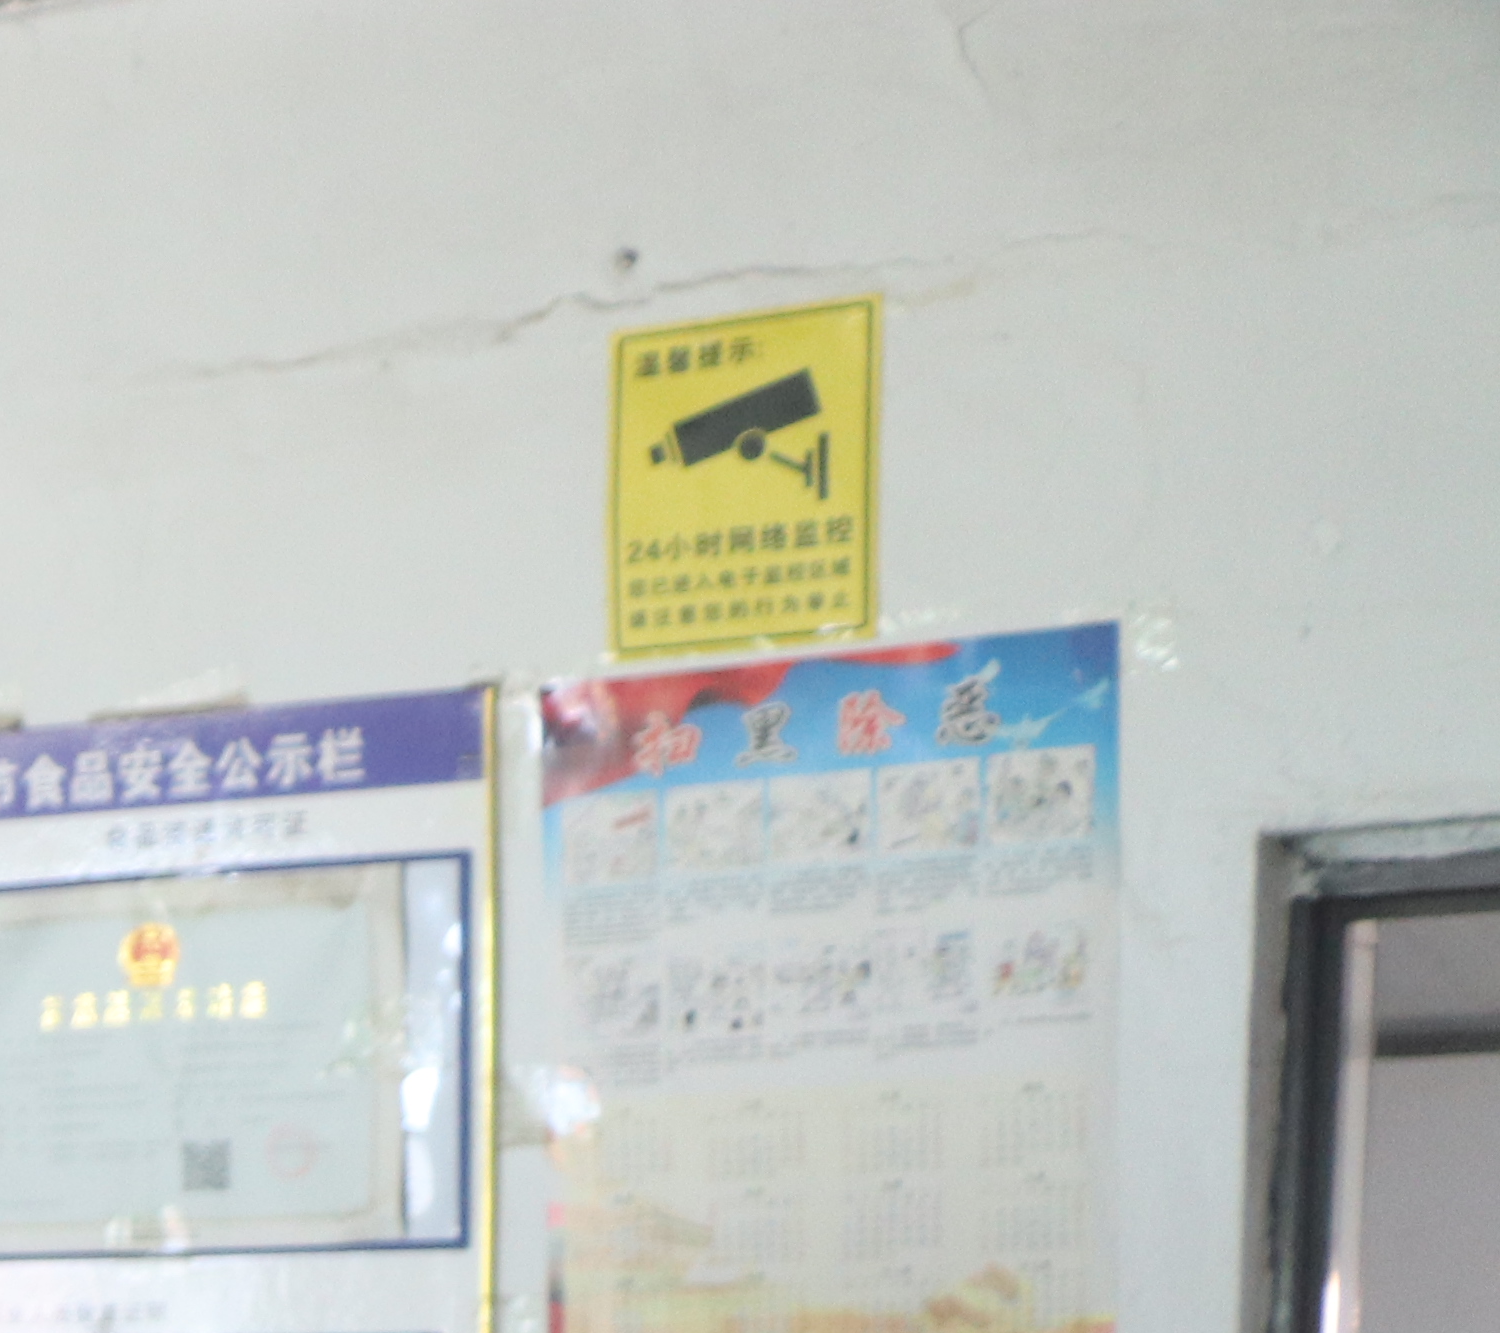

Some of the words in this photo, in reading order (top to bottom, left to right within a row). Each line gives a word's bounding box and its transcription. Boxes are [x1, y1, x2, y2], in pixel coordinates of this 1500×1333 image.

[627, 514, 854, 564] 24小时网络监控
